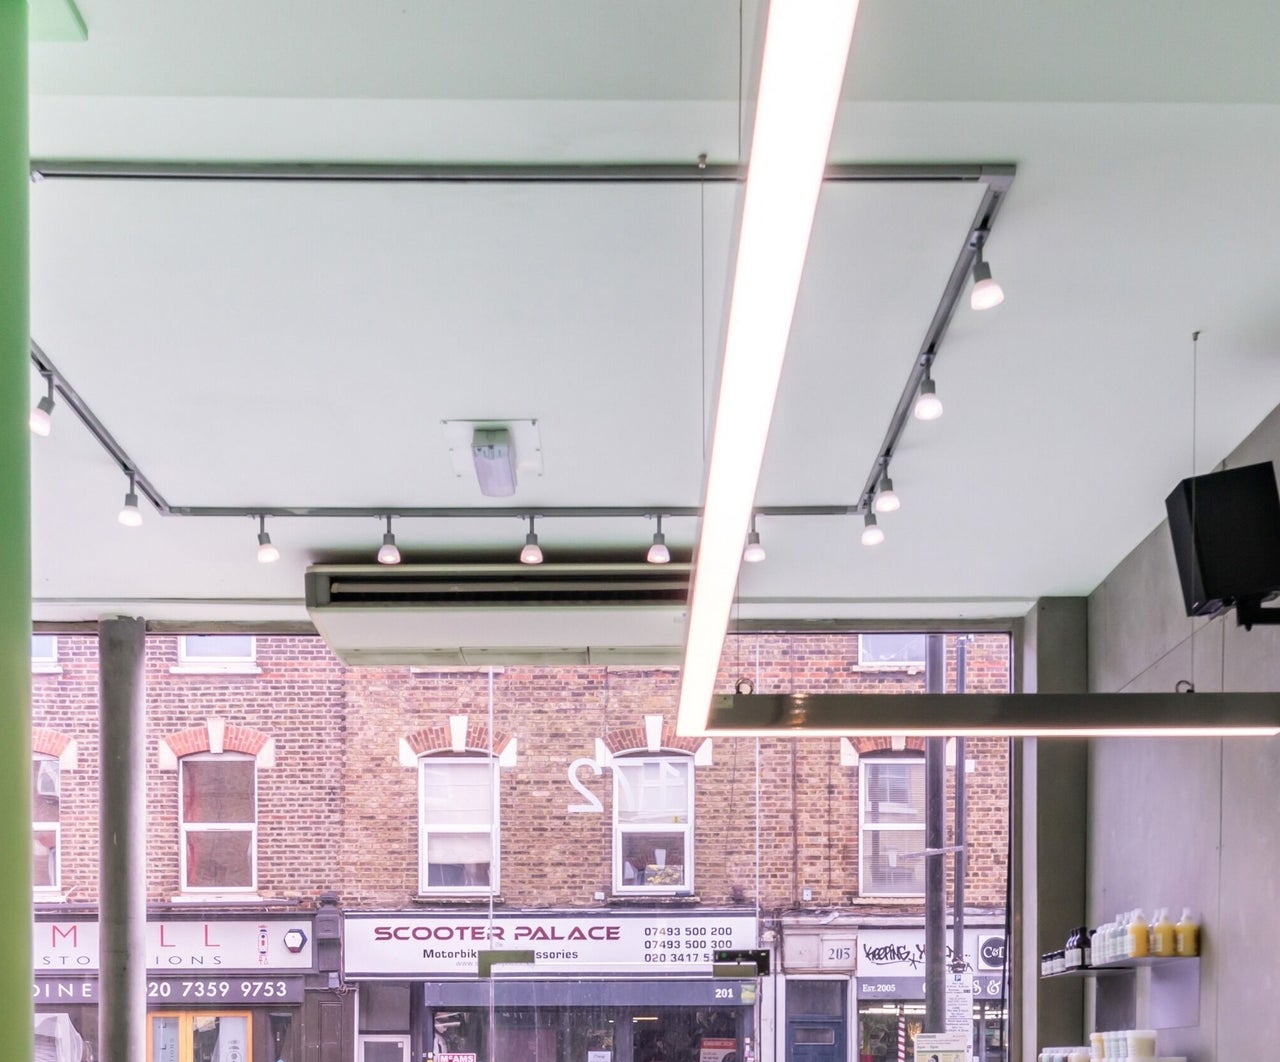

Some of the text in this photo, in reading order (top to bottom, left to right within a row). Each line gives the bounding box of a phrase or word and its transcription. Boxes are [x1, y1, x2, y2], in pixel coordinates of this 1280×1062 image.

[374, 926, 621, 941] SCOOTER PALACE
[644, 927, 733, 936] 07493 500 200
[644, 940, 733, 949] 07493 500 300
[423, 949, 579, 959] Motorbik ssories
[644, 953, 666, 963] 020
[670, 953, 699, 963] 3417
[828, 948, 851, 960] 203
[146, 981, 171, 998] 20
[182, 981, 230, 998] 7359
[241, 981, 287, 998] 9753
[714, 988, 734, 998] 201
